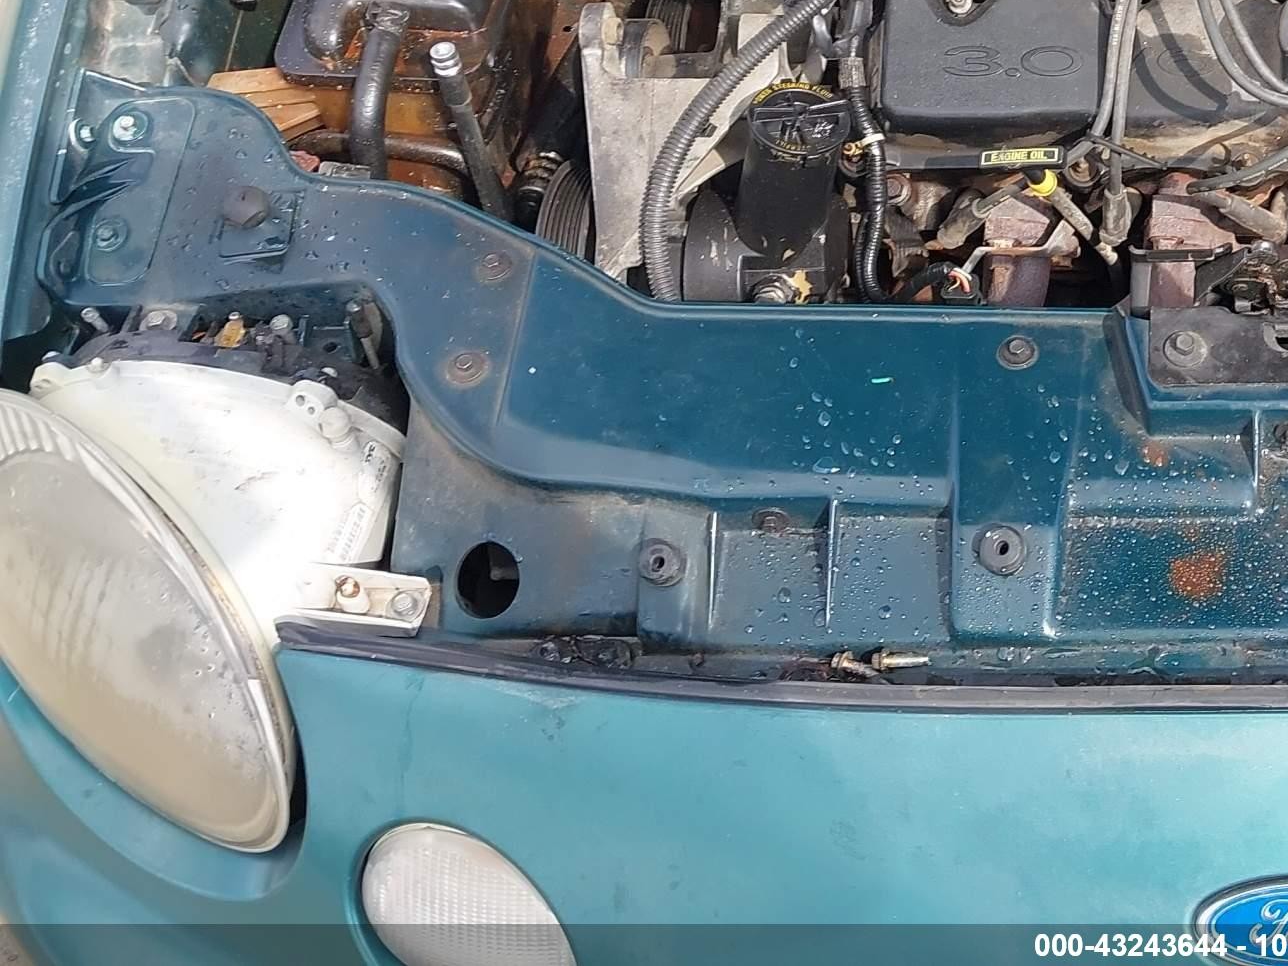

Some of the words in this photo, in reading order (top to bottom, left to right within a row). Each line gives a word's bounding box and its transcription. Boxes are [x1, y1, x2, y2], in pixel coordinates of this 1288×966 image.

[942, 44, 1083, 78] 3.0
[811, 85, 833, 99] FLUID
[990, 151, 1027, 162] ENGINE
[1029, 150, 1048, 160] OIL
